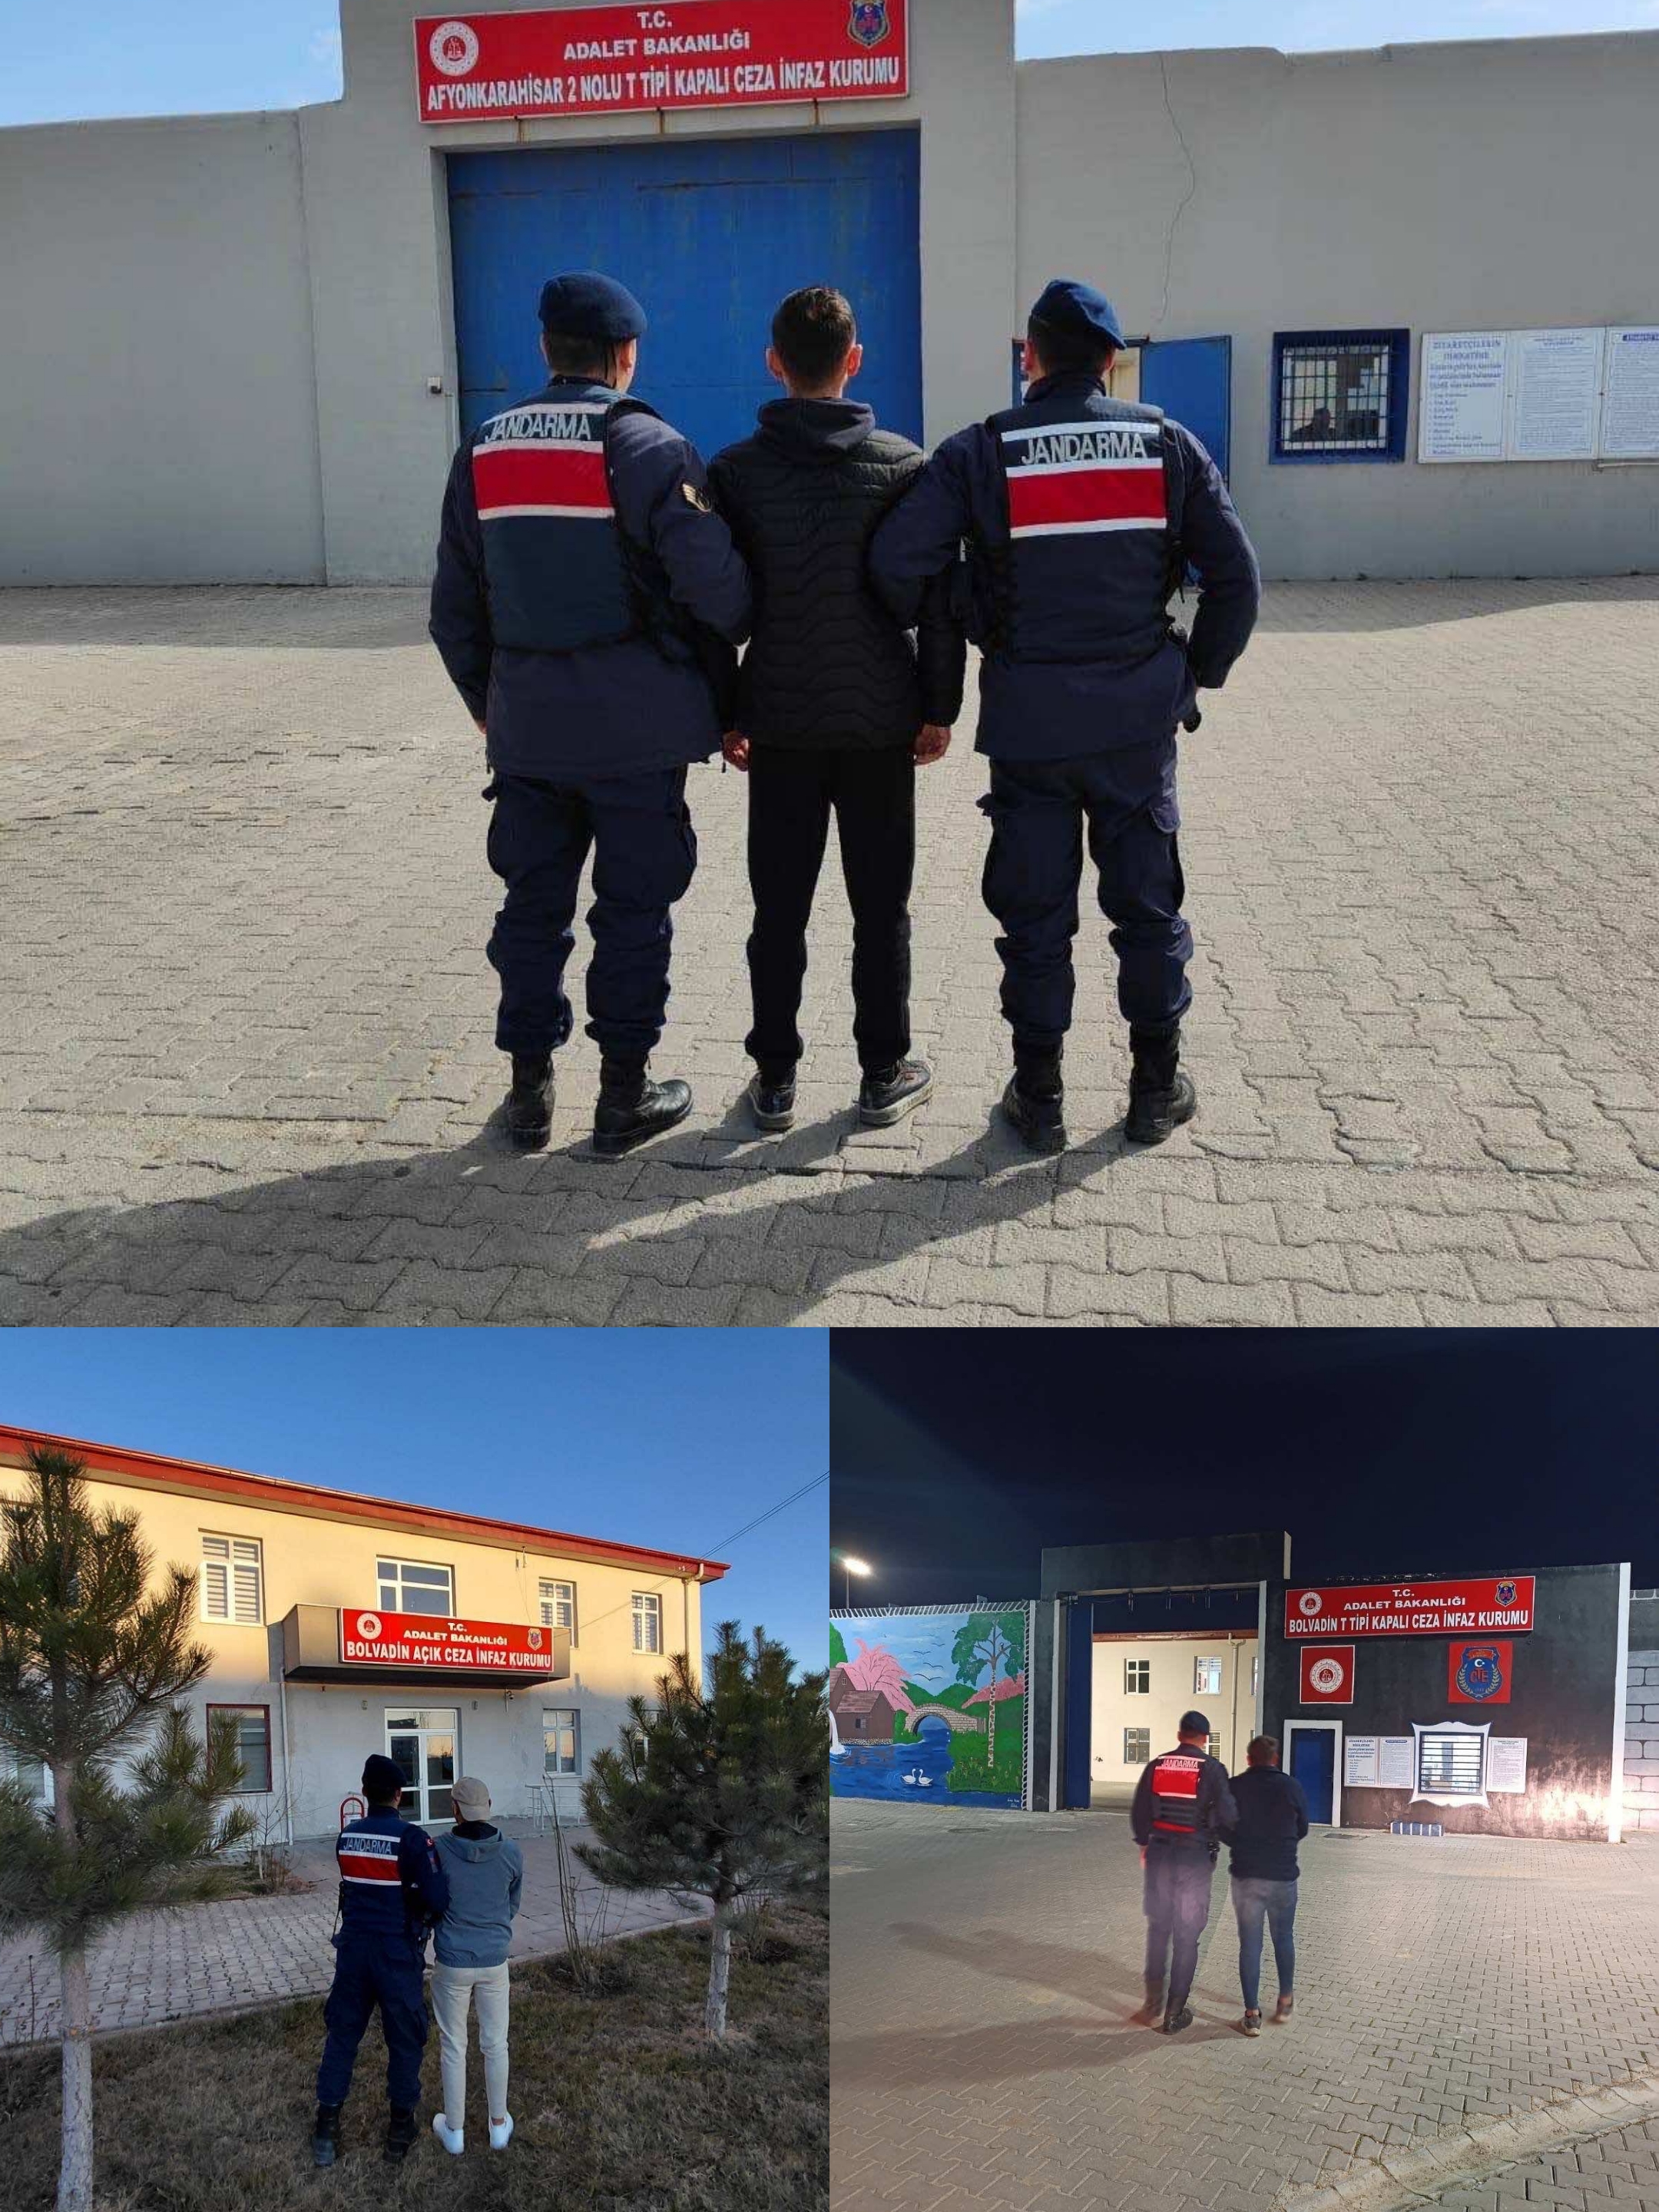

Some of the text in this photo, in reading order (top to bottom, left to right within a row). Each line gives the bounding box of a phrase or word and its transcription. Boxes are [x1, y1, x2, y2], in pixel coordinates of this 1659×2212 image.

[637, 11, 673, 28] T.C.
[564, 28, 750, 60] ADALET BAKANLIĞI
[427, 57, 899, 111] AFYONKARAHİSAR 2 NOLU T TİPİ KAPALI CEZA İNFAZ KURUMU
[485, 412, 591, 442] JANDARMA
[1021, 432, 1147, 465] JANDARMA
[1344, 1596, 1465, 1611] ADALET BAKANLIĞI
[447, 1622, 467, 1632] T.C.
[1289, 1610, 1528, 1633] BOLVADİN T TİPİ KAPALI CEZA İNFAZ KURUMU
[403, 1630, 508, 1646] ADALET BAKANLIĞI
[346, 1641, 551, 1668] BOLVADİN AÇIK CEZA İNFAZ KURUMU
[1161, 1758, 1198, 1769] JANDARMA
[343, 1837, 392, 1855] JANDARMA
